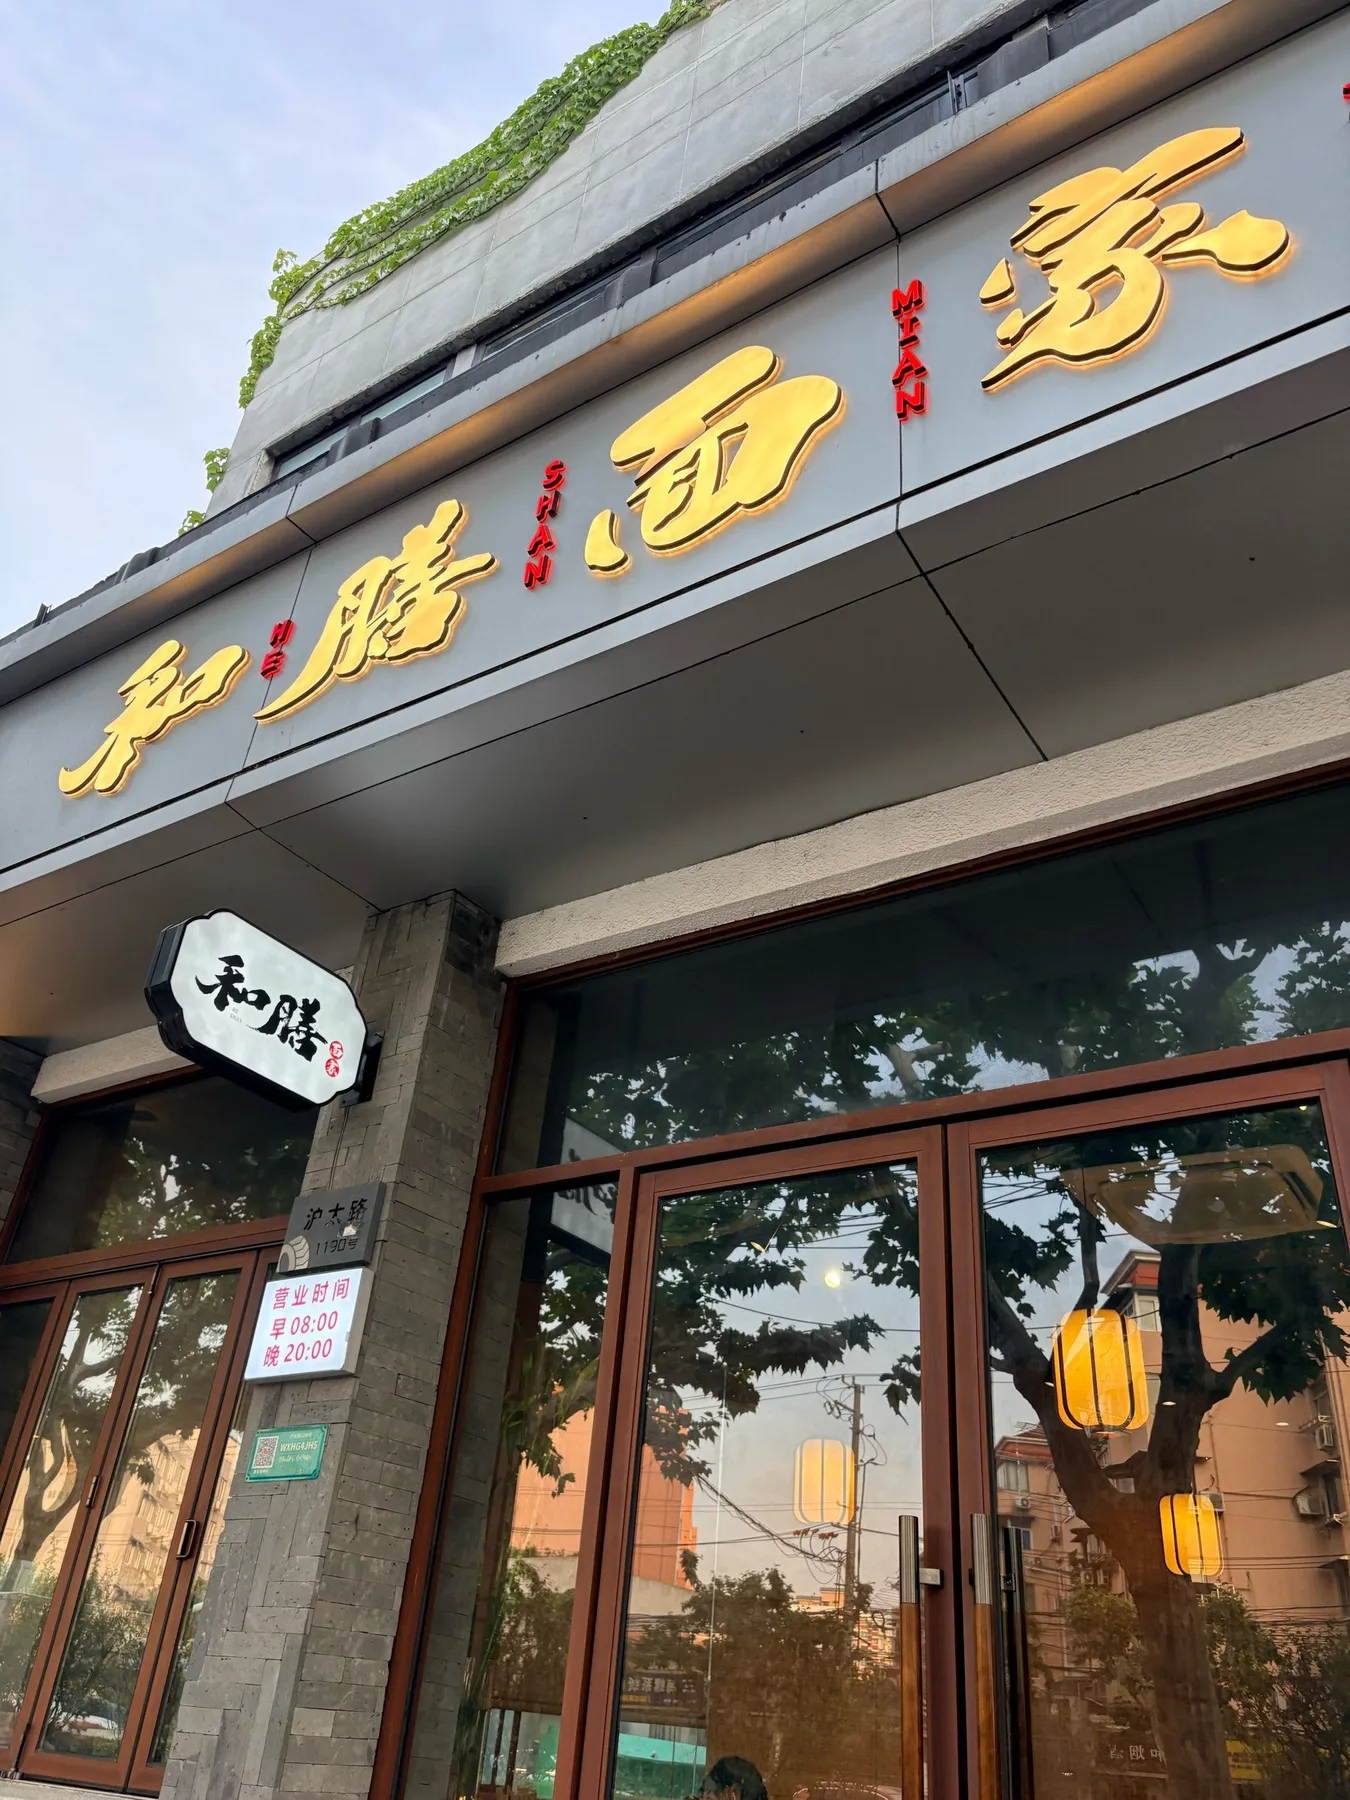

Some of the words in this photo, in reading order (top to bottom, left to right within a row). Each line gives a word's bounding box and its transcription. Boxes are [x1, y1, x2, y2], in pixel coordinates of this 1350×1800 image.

[891, 278, 928, 423] MIAN
[523, 459, 567, 590] SHAN
[260, 619, 296, 680] HE
[195, 954, 328, 1062] 和膳
[303, 1198, 368, 1231] 沪太路
[315, 1237, 358, 1256] 1190号
[273, 1277, 350, 1310] 营业时间
